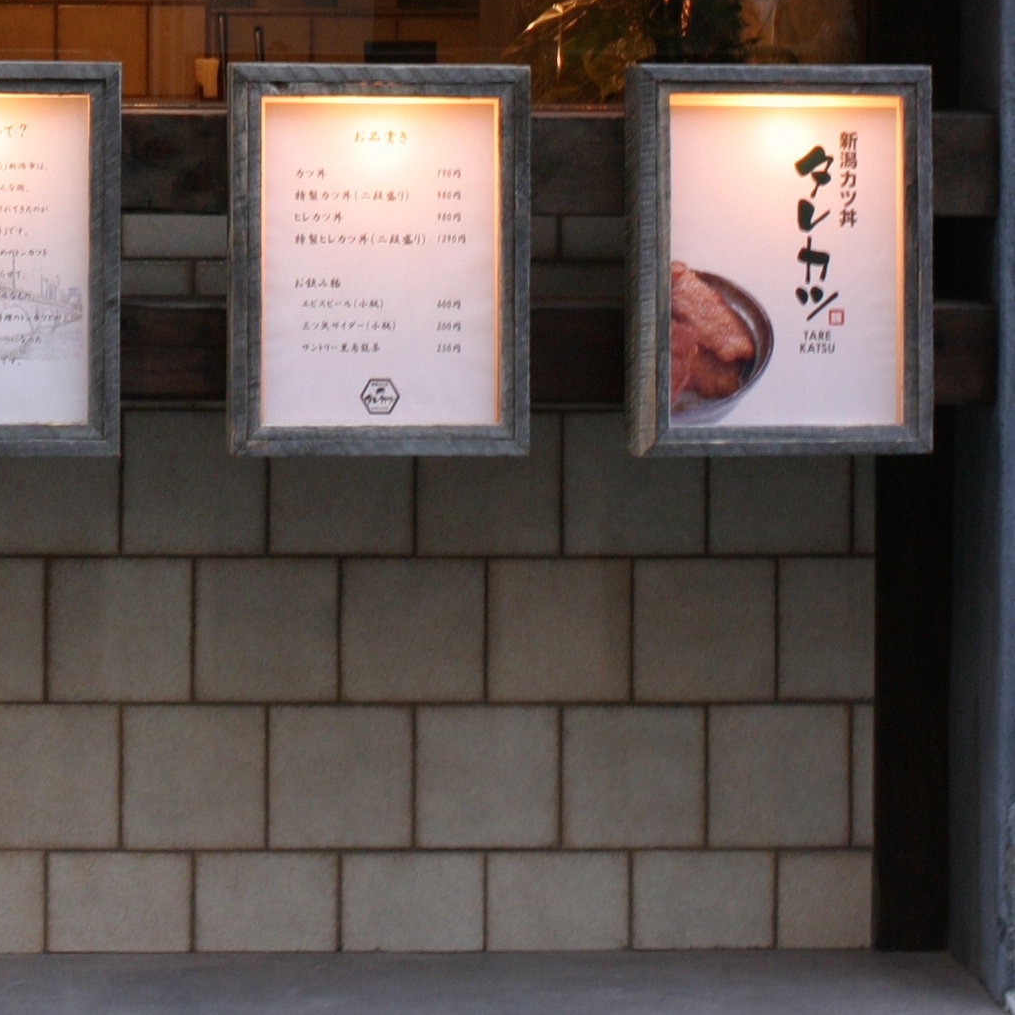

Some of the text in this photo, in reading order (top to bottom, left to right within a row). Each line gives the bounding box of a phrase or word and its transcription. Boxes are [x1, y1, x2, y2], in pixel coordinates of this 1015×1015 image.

[353, 130, 408, 144] お品書き
[295, 168, 327, 179] カツ丼
[839, 131, 858, 228] 新潟カツ丼
[294, 212, 343, 223] ヒレカツ丼
[794, 145, 839, 321] タレカツ
[294, 277, 342, 289] お飲み物
[803, 330, 832, 342] TARE
[799, 342, 836, 354] KATSU
